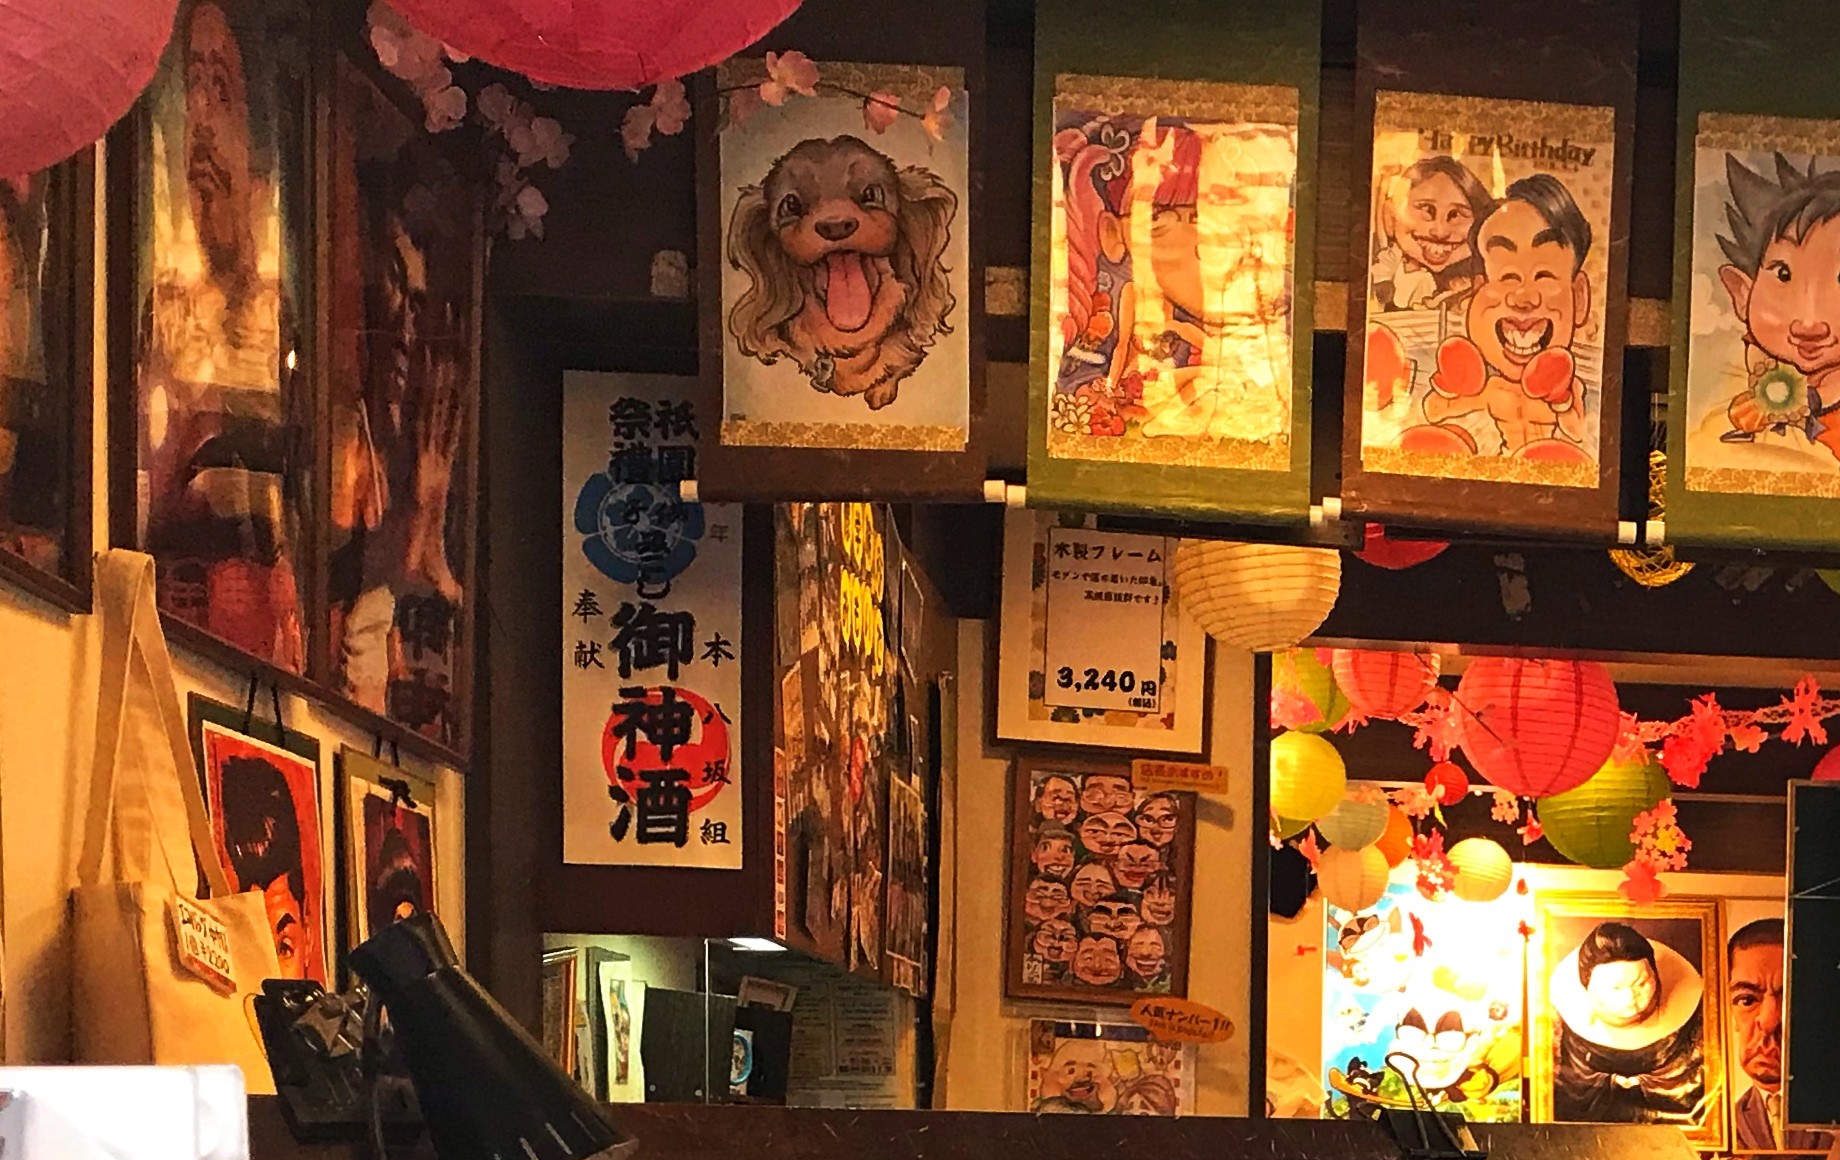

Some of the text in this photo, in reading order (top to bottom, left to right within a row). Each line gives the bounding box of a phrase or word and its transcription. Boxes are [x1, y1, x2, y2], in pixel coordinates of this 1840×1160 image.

[1417, 127, 1597, 167] Hapy Birthday
[1054, 541, 1162, 563] 木製フレーム
[572, 588, 606, 671] 奉献
[608, 602, 697, 849] 御神酒
